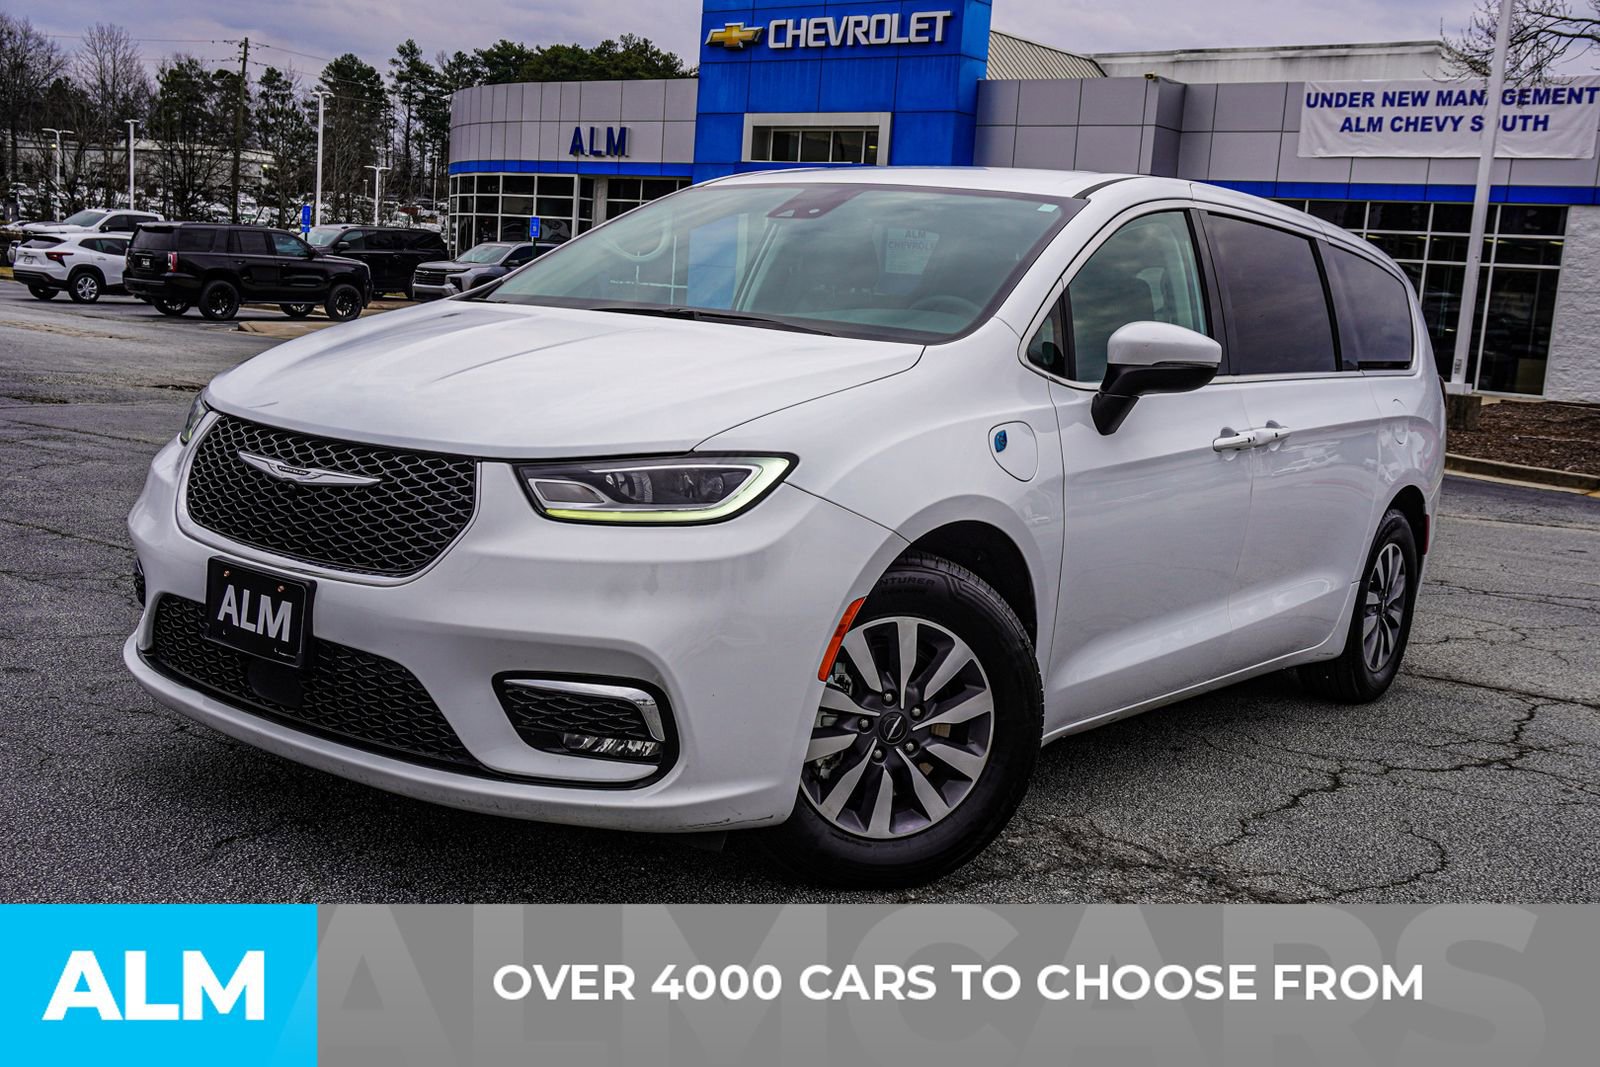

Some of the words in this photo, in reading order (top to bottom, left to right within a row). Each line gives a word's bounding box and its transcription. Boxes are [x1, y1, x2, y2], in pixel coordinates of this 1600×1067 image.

[768, 11, 952, 48] CHEVROLET
[1305, 90, 1374, 109] UNDER
[1381, 90, 1431, 108] NEW
[1435, 86, 1600, 107] MANGEMENT
[1339, 116, 1384, 133] ALM
[1390, 115, 1465, 132] CHEVY
[1470, 114, 1550, 132] SUTH
[569, 126, 629, 156] ALM
[904, 228, 927, 239] ALM
[216, 583, 293, 644] ALM
